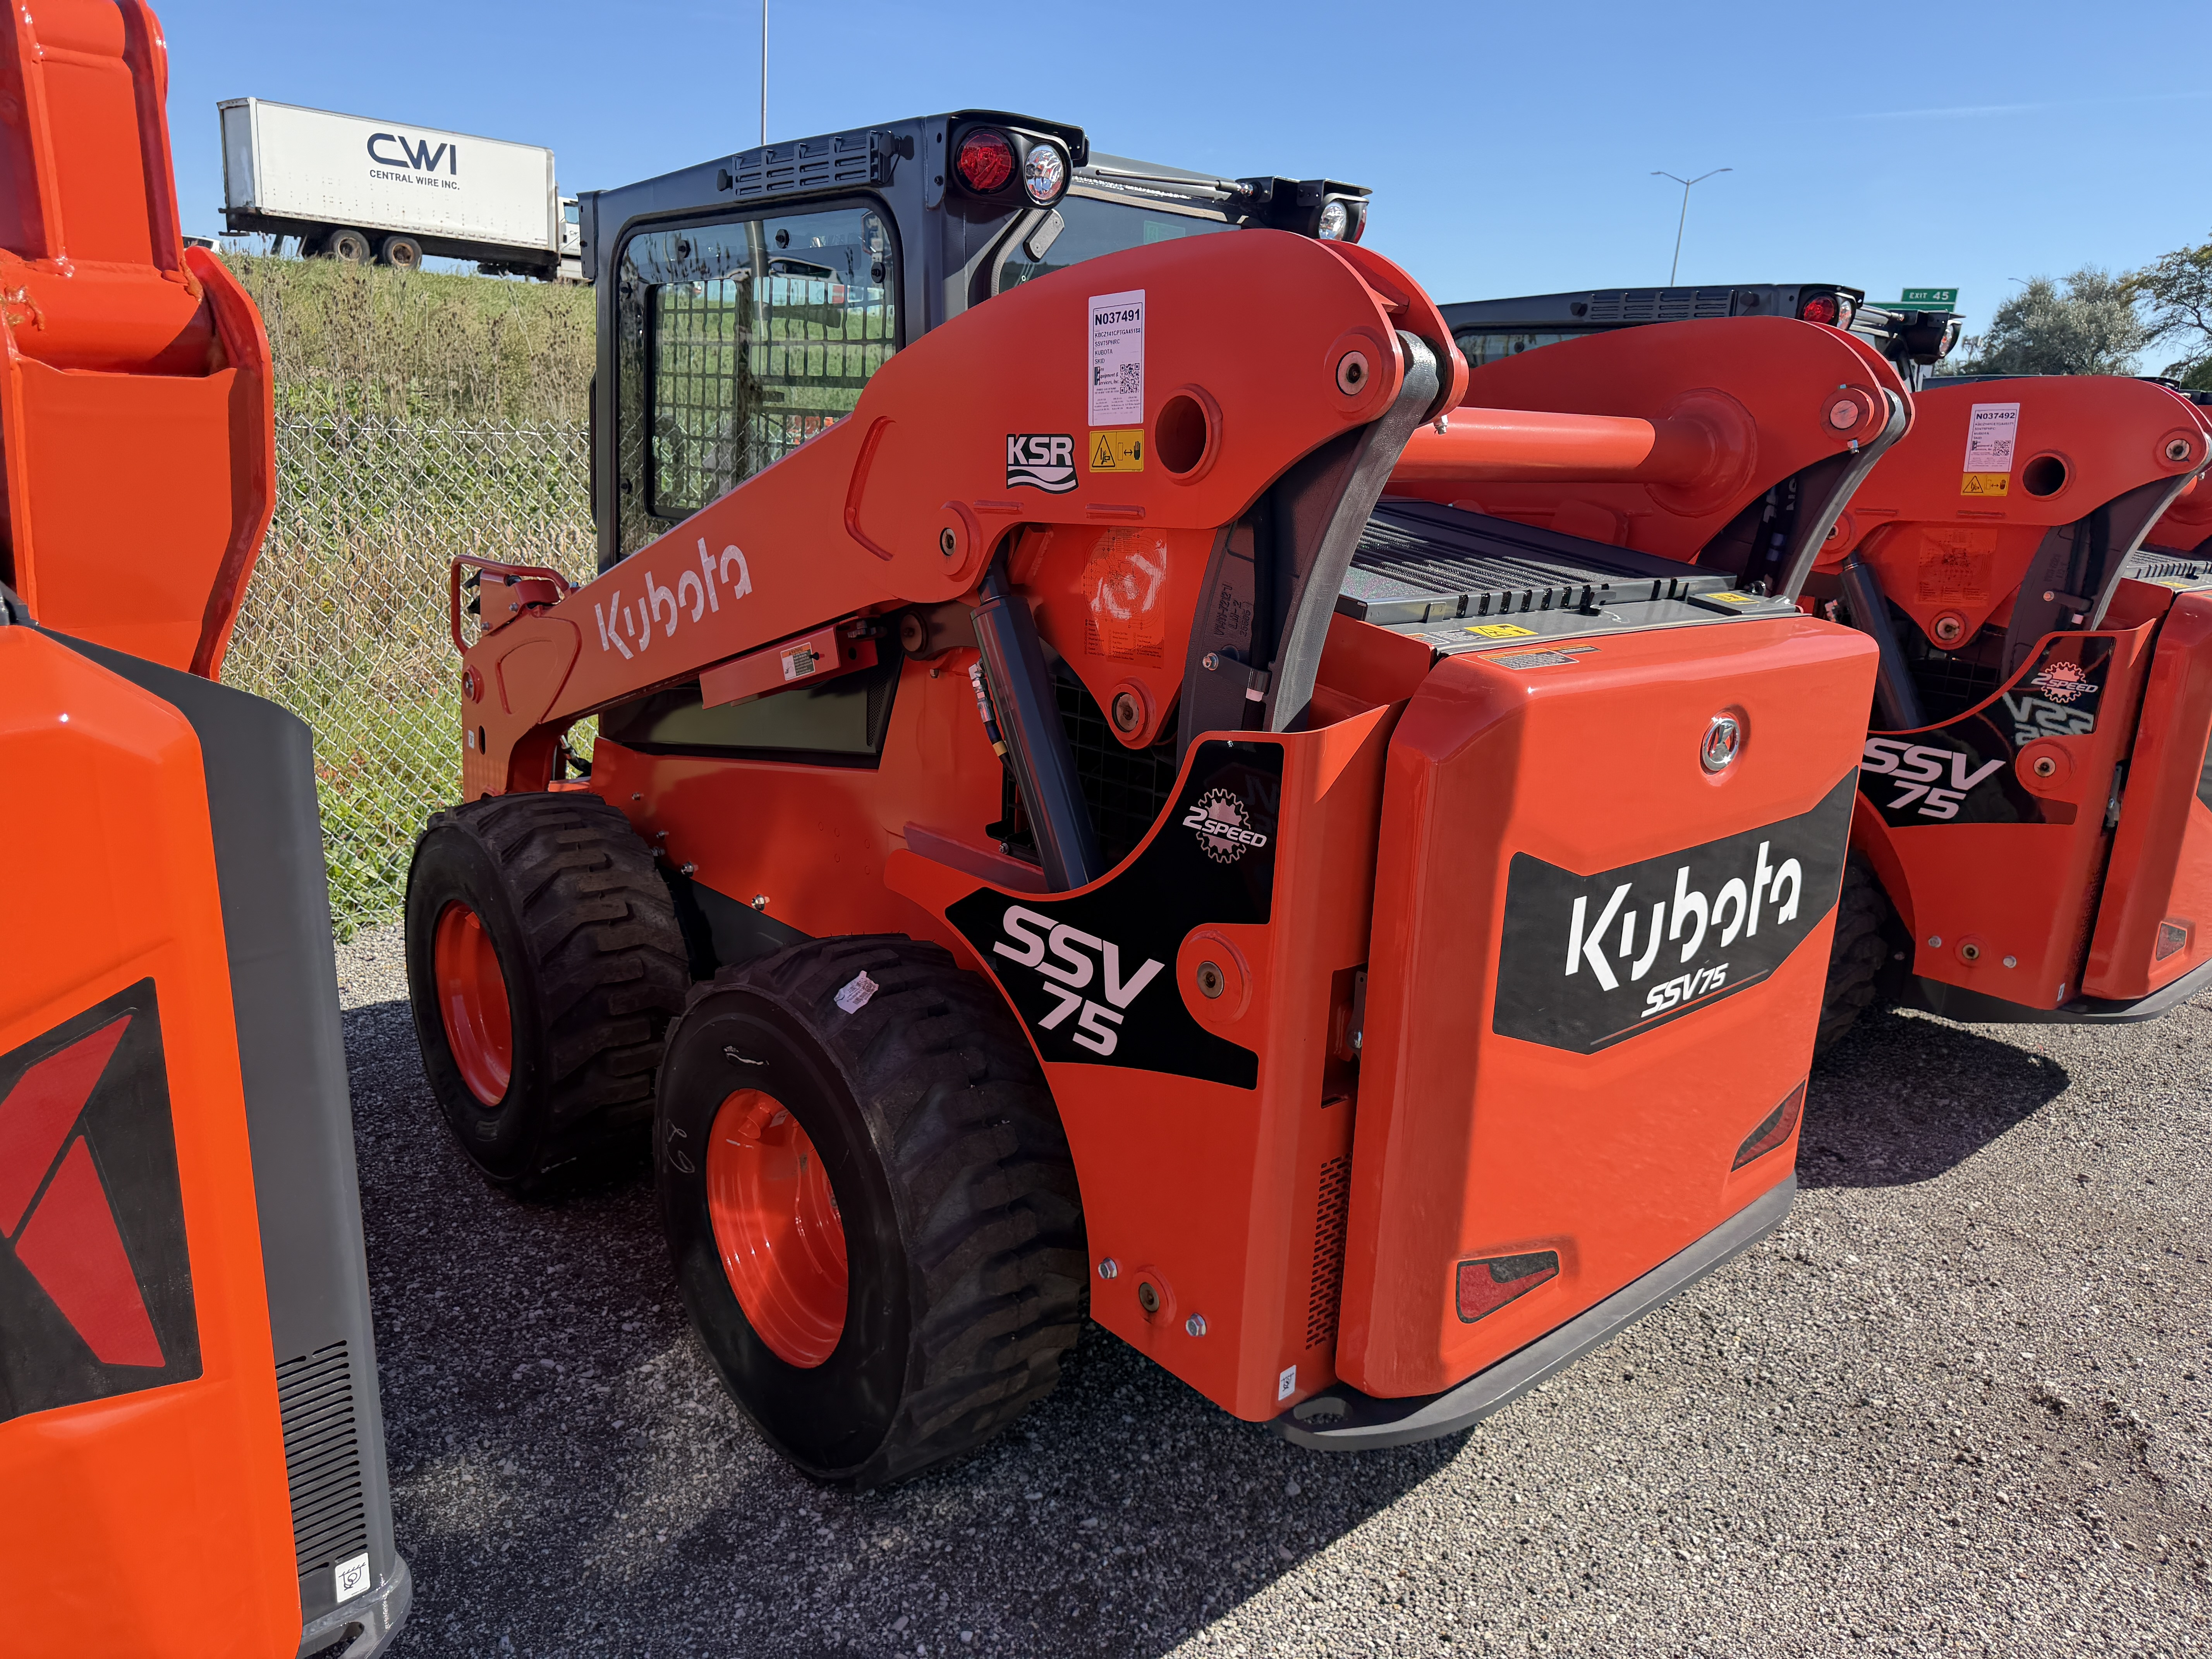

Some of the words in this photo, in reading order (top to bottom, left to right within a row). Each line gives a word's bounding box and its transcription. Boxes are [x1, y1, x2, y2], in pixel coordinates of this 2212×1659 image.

[367, 133, 456, 175] CWI
[369, 170, 414, 183] CENTRAL
[416, 175, 439, 187] WIRE
[441, 179, 460, 190] INC.
[1095, 309, 1139, 325] N037491
[1933, 292, 1949, 300] 45
[1008, 437, 1072, 465] KSR
[594, 537, 752, 660] Kubota
[1861, 738, 2006, 790] SSV
[1887, 780, 1966, 819] 75
[1565, 840, 1802, 991] Kubota
[993, 905, 1165, 1009] SSV
[1640, 963, 1729, 1018] SSV75
[1038, 981, 1124, 1056] 75
